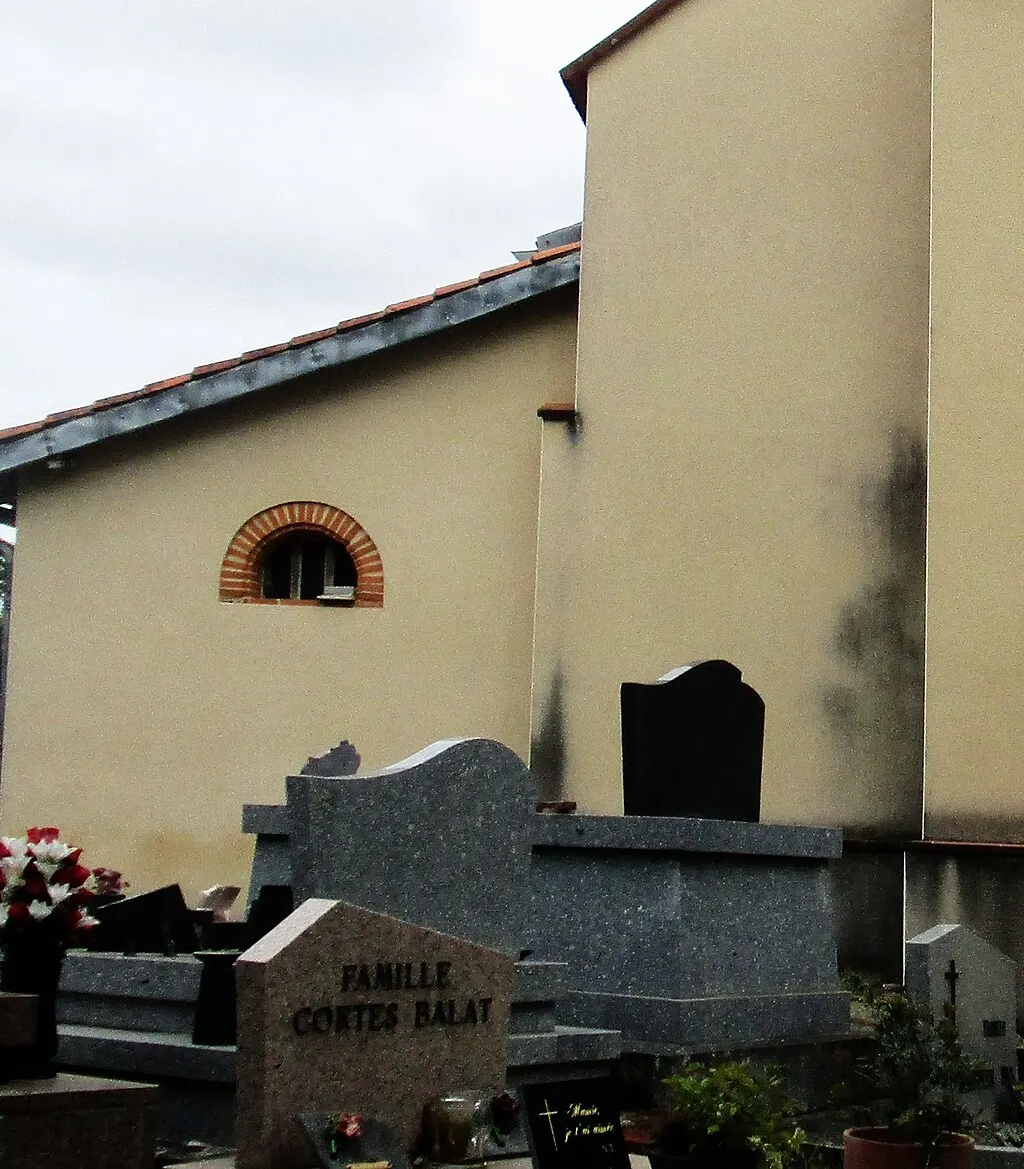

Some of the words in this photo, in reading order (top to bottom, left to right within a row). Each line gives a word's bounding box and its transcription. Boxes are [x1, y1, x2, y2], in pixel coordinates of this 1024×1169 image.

[342, 961, 452, 992] FAMILLE
[293, 1002, 399, 1035] CORTES
[414, 997, 492, 1029] BALAT
